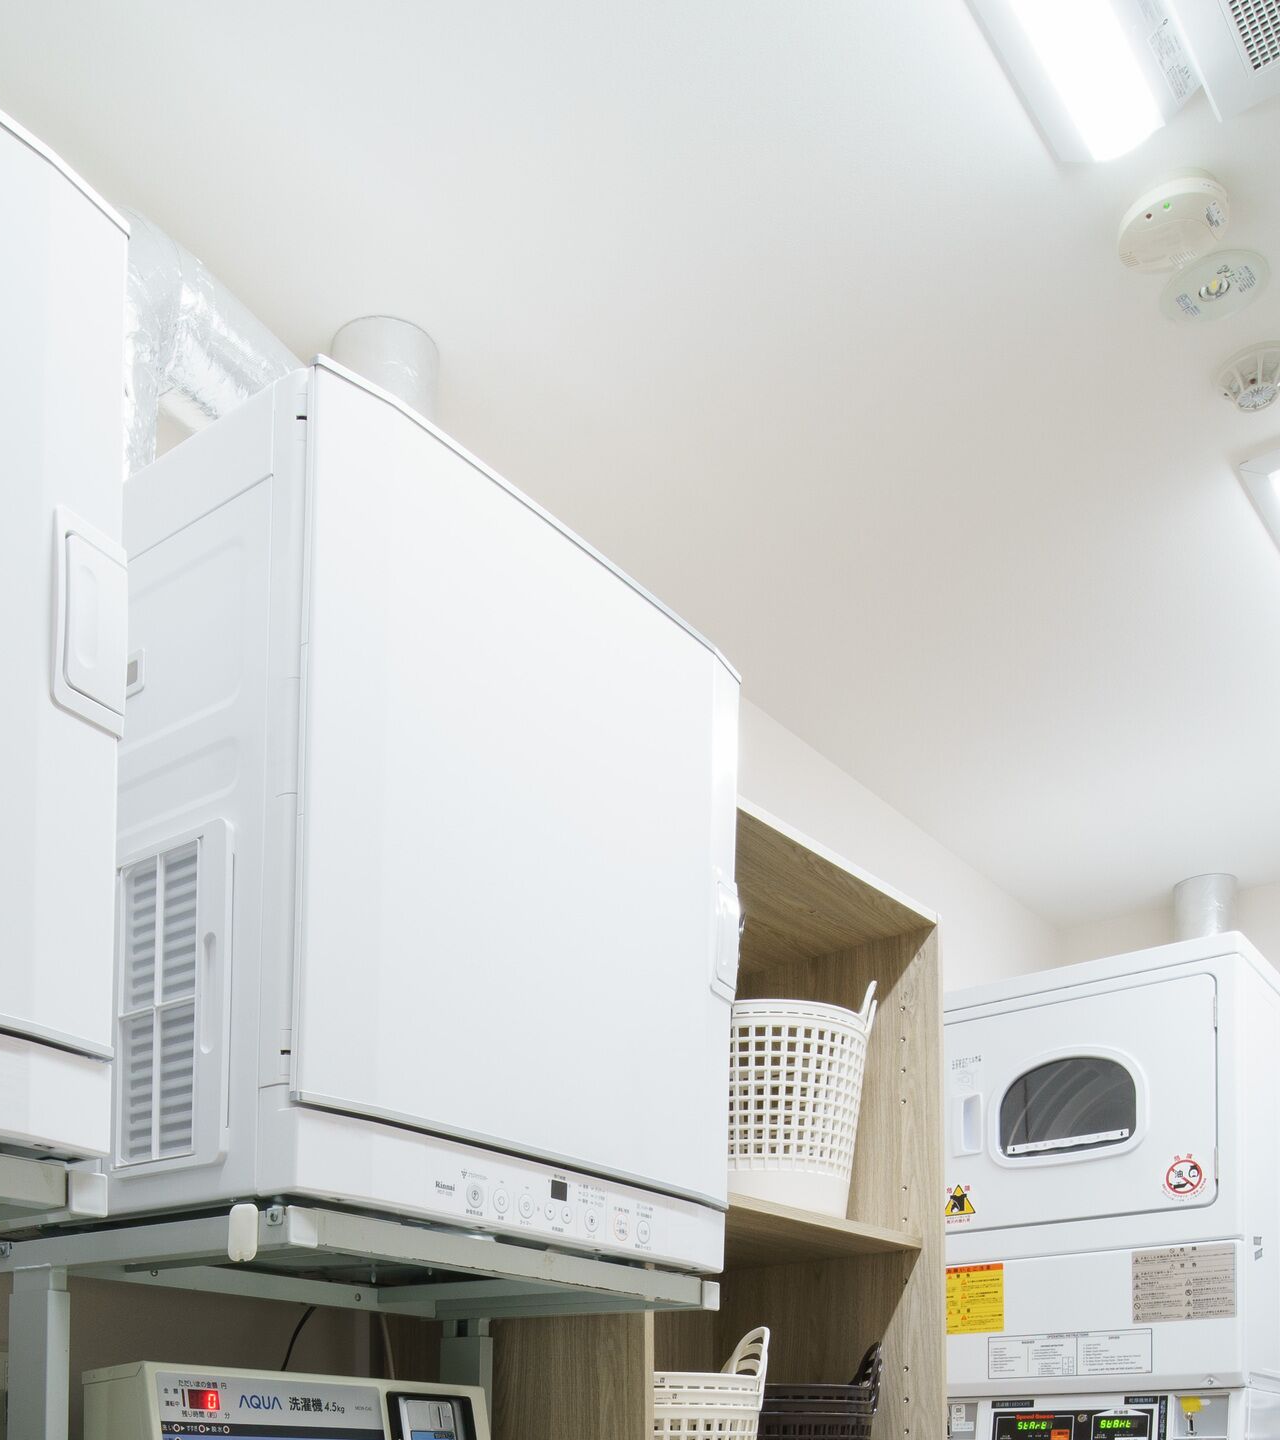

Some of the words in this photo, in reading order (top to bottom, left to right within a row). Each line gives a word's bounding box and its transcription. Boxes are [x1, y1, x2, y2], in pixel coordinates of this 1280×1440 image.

[1174, 1170, 1184, 1178] 油
[435, 1180, 456, 1192] Rinnai
[178, 1379, 219, 1389] ただいまの金額
[207, 1393, 217, 1410] 0
[239, 1394, 283, 1410] AQUA
[288, 1396, 324, 1412] 洗濯機
[324, 1401, 346, 1415] 4.5kg
